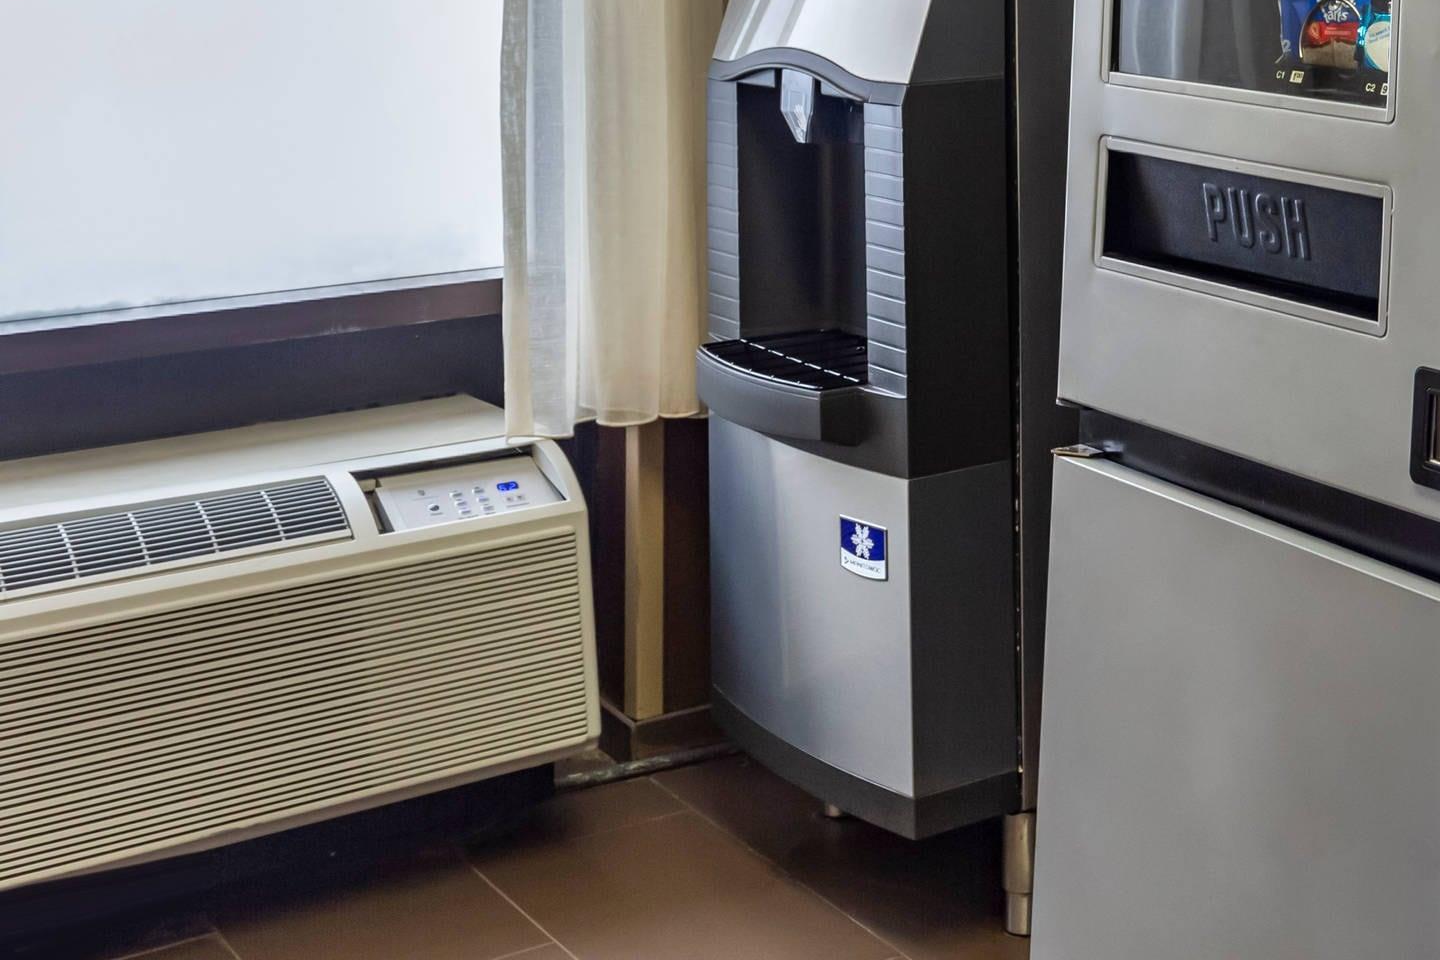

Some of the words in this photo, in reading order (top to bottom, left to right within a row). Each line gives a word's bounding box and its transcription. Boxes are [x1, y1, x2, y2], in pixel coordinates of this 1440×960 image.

[1276, 70, 1286, 79] C1
[1365, 83, 1376, 92] C2
[1202, 182, 1311, 261] PUSH
